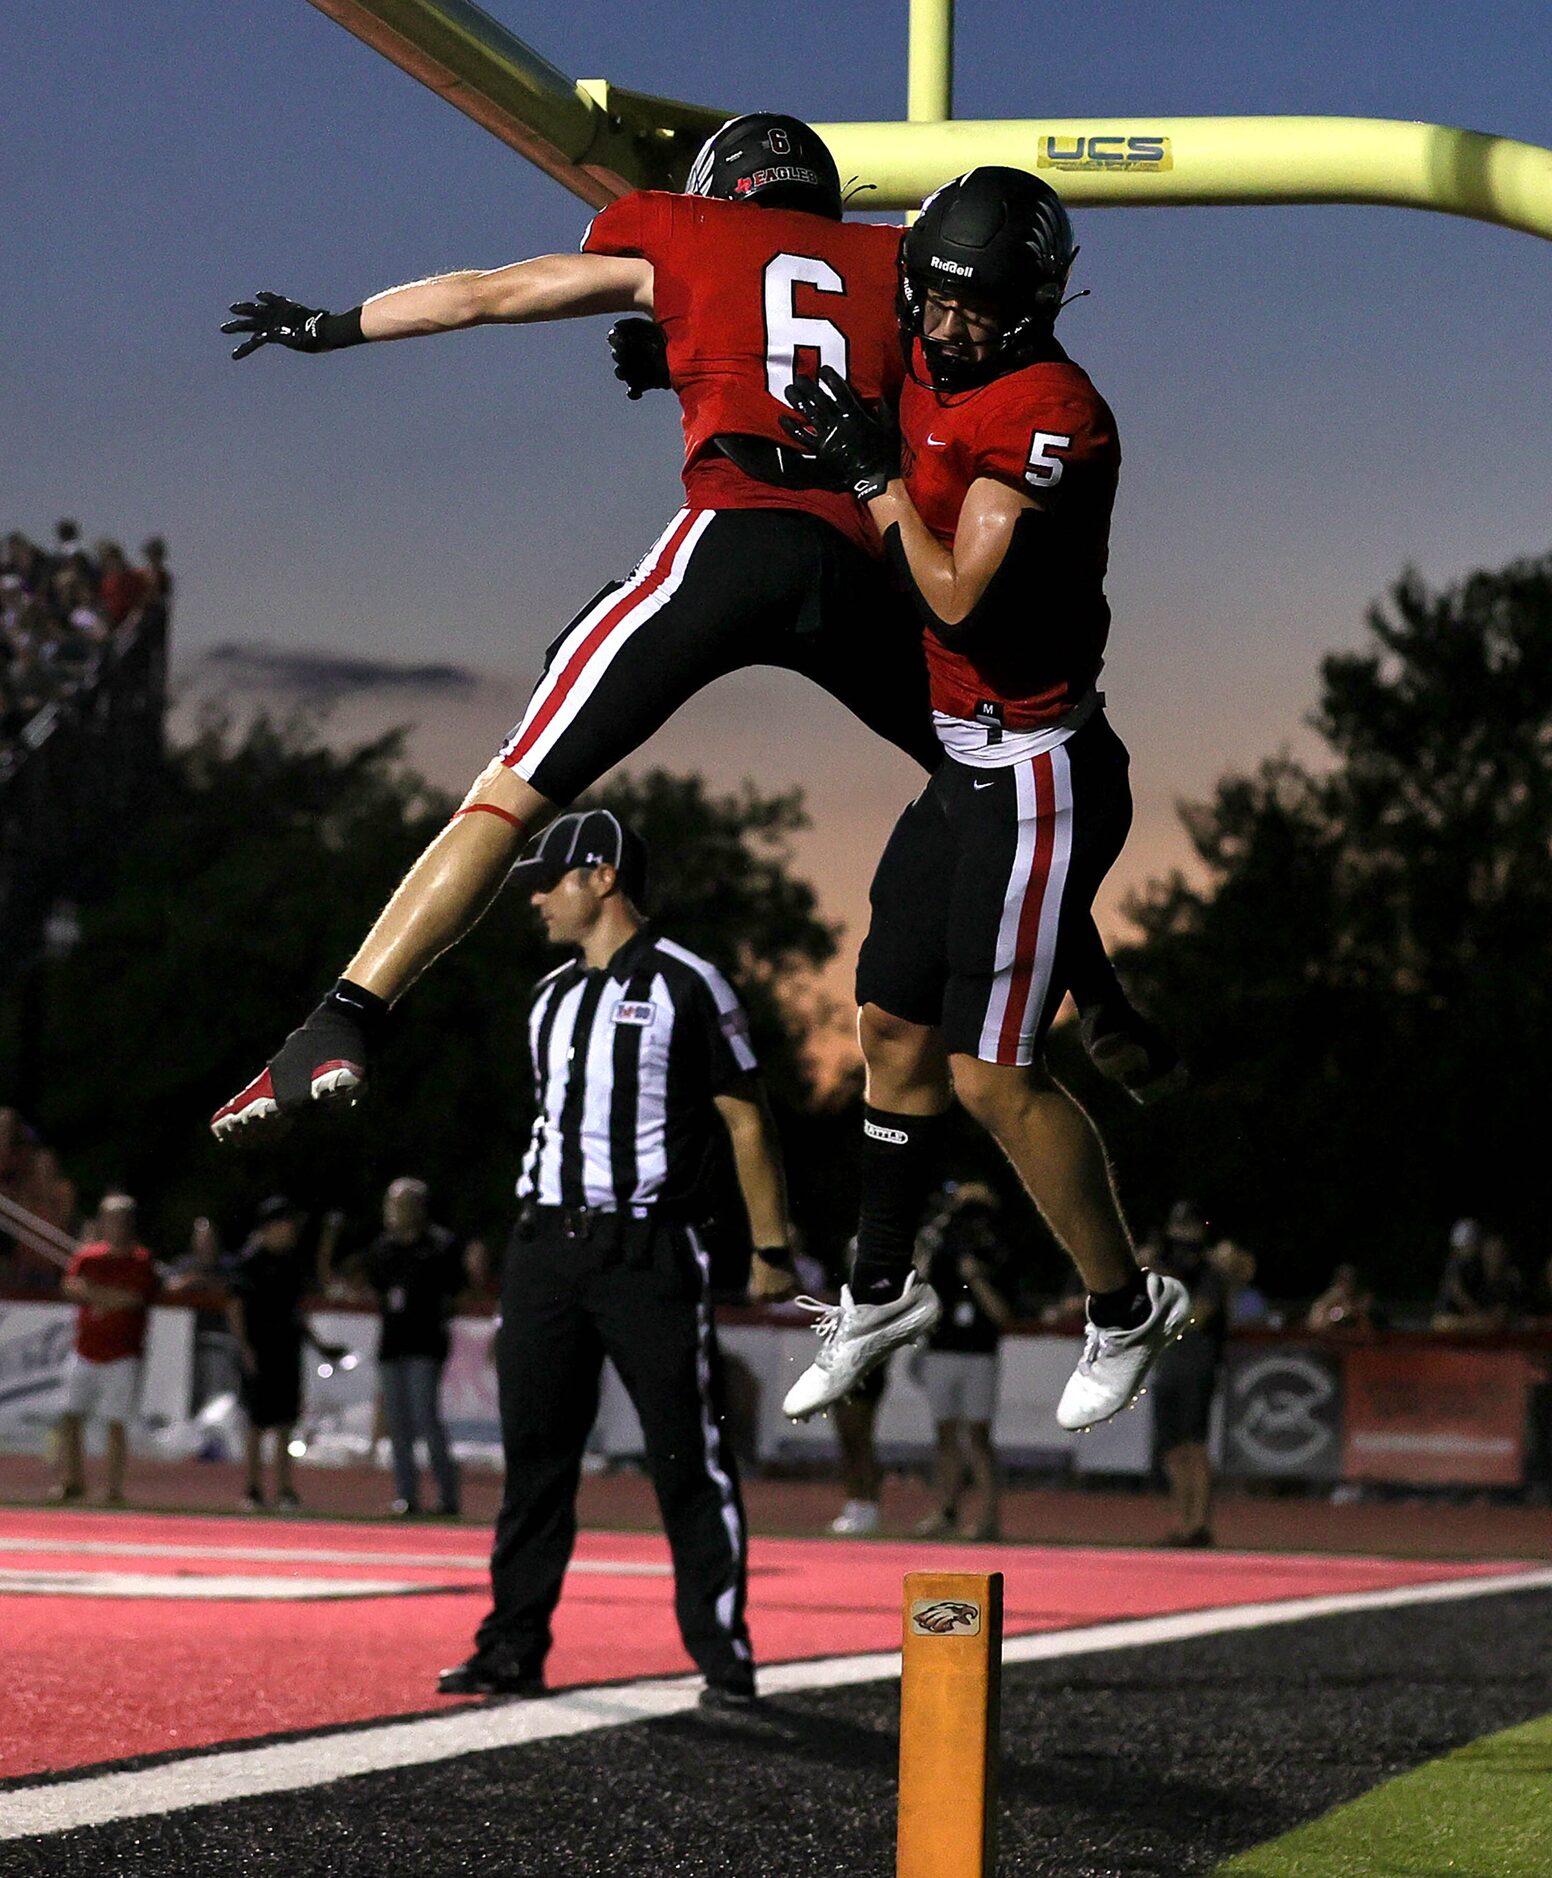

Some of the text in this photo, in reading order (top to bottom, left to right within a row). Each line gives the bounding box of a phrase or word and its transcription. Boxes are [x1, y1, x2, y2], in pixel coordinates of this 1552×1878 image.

[767, 128, 790, 154] 6
[1047, 136, 1164, 160] UCS
[753, 167, 818, 187] EAGLES
[930, 256, 974, 278] Riddell
[763, 251, 848, 410] 6
[1024, 431, 1071, 488] 5
[982, 703, 994, 715] M
[866, 1123, 904, 1142] ATTLE
